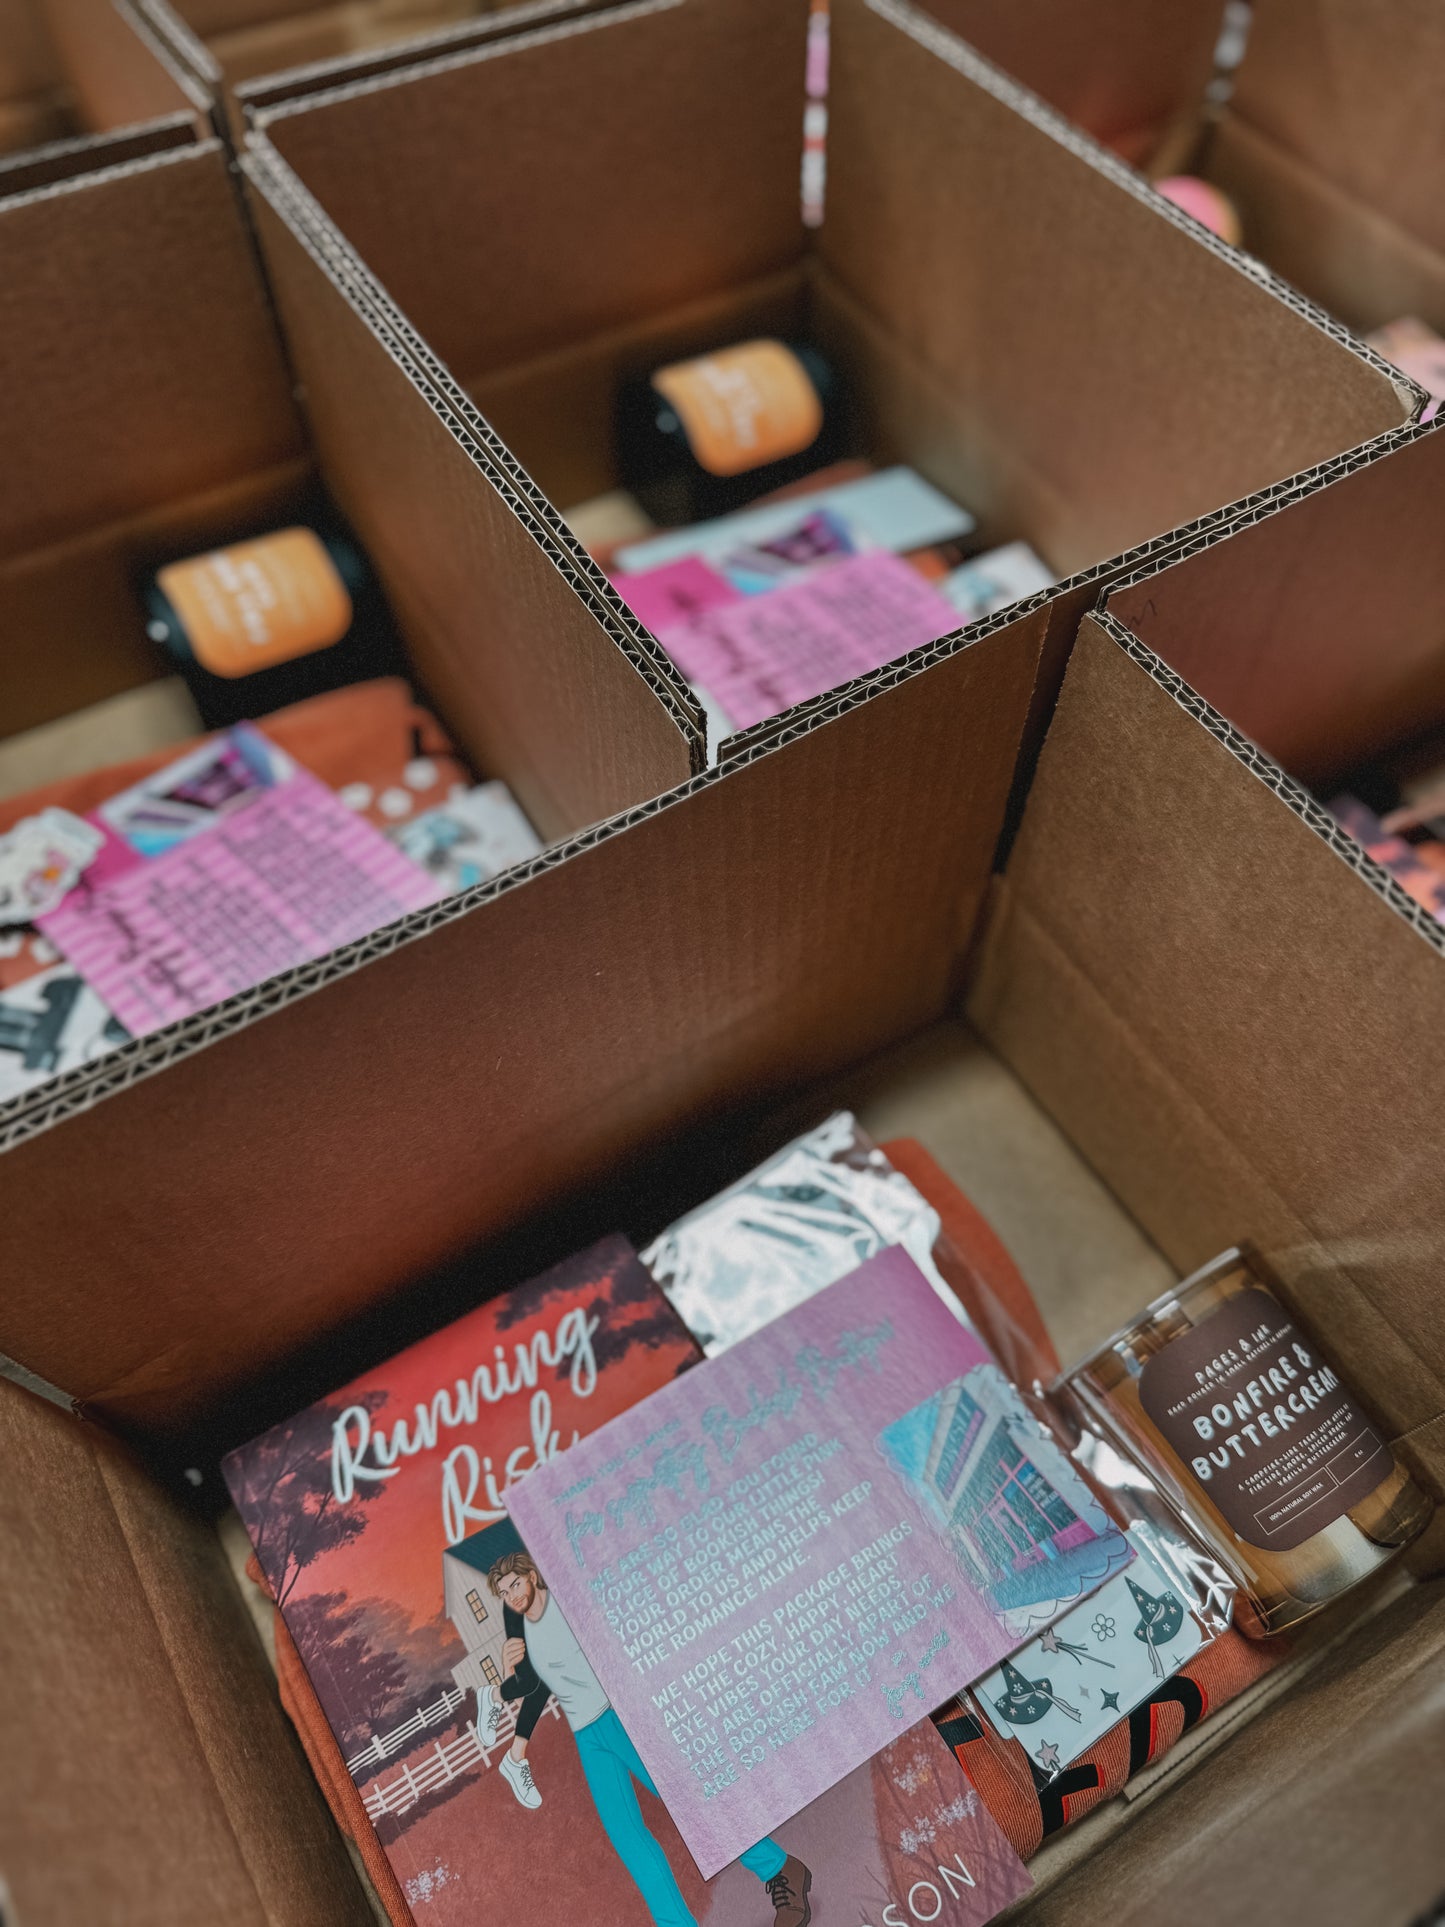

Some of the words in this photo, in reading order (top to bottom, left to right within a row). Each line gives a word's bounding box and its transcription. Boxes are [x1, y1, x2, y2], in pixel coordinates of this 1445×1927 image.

[331, 1308, 599, 1504] Running
[1166, 1400, 1187, 1417] HAND
[1186, 1380, 1215, 1403] POURED
[1214, 1373, 1226, 1383] IN
[1224, 1358, 1247, 1377] SMALL
[1190, 1364, 1339, 1482] BUTTERCREAM
[1191, 1354, 1300, 1442] BONFIRE
[1290, 1341, 1315, 1369] &
[1193, 1347, 1240, 1385] PAGES
[1237, 1337, 1253, 1353] &
[1250, 1323, 1271, 1343] INK
[586, 1564, 617, 1593] WE
[615, 1540, 654, 1574] ARE
[651, 1523, 680, 1550] SO
[677, 1493, 726, 1532] GLAD
[724, 1469, 762, 1501] YOU
[758, 1430, 820, 1478] FOUND
[596, 1567, 648, 1609] YOUR
[644, 1541, 687, 1577] WAY
[684, 1524, 711, 1550] TO
[708, 1498, 750, 1533] OUR
[745, 1461, 804, 1507] LITTLE
[605, 1583, 657, 1626] SLICE
[655, 1564, 684, 1592] OF
[681, 1513, 760, 1573] BOOKISH
[756, 1468, 827, 1522] THINGS!
[1269, 1510, 1282, 1522] 100%
[1280, 1495, 1304, 1513] NATURAL
[1301, 1489, 1313, 1499] SOY
[1310, 1481, 1323, 1492] WAX
[1276, 1462, 1307, 1486] VANILLA
[613, 1598, 666, 1642] YOUR
[663, 1557, 727, 1608] ORDER
[724, 1517, 787, 1567] MEANS
[783, 1493, 821, 1526] THE
[622, 1606, 688, 1659] WORLD
[687, 1588, 714, 1615] TO
[713, 1570, 741, 1597] US
[738, 1544, 779, 1580] AND
[776, 1507, 833, 1554] HELPS
[829, 1477, 876, 1517] KEEP
[631, 1642, 670, 1676] THE
[668, 1581, 758, 1651] ROMANCE
[755, 1545, 812, 1591] ALIVE.
[651, 1680, 682, 1710] WE
[681, 1645, 732, 1689] HOPE
[730, 1617, 773, 1654] THIS
[771, 1562, 852, 1625] PACKAGE
[849, 1519, 914, 1570] BRINGS
[660, 1693, 697, 1728] ALL
[695, 1668, 733, 1703] THE
[844, 1550, 902, 1597] HEART
[671, 1710, 707, 1745] EYE
[705, 1673, 760, 1720] VIBES
[759, 1638, 810, 1682] YOUR
[808, 1613, 846, 1647] DAY
[680, 1726, 721, 1764] YOU
[719, 1699, 759, 1735] ARE
[757, 1629, 856, 1708] OFFICIALLY
[854, 1589, 912, 1638] APART
[909, 1571, 937, 1598] OF
[689, 1744, 729, 1783] THE
[727, 1687, 809, 1754] BOOKISH
[807, 1658, 849, 1696] FAM
[847, 1627, 892, 1667] NOW
[889, 1600, 929, 1636] AND
[925, 1580, 956, 1610] WE
[699, 1762, 740, 1802] ARE
[738, 1742, 767, 1772] SO
[766, 1706, 817, 1752] HERE
[815, 1678, 855, 1715] FOR
